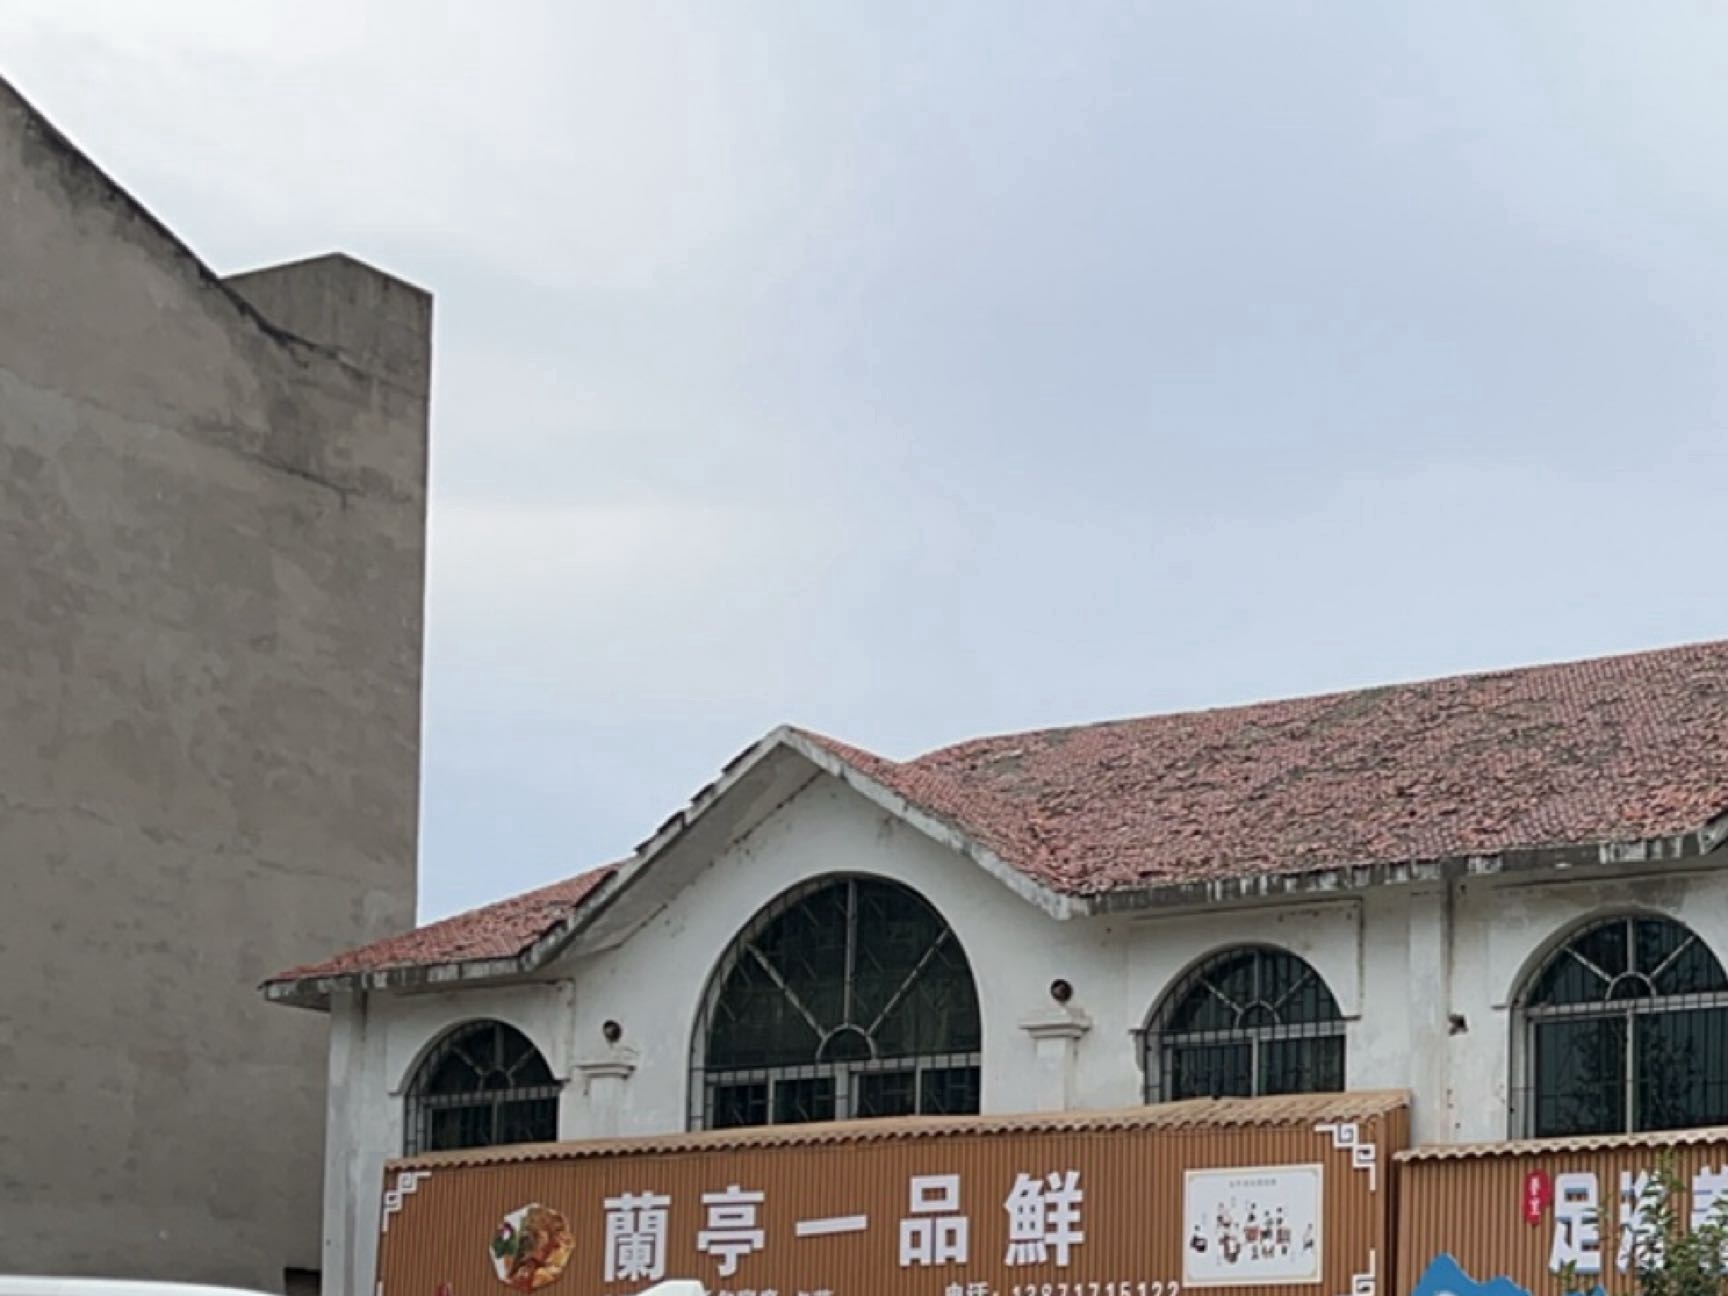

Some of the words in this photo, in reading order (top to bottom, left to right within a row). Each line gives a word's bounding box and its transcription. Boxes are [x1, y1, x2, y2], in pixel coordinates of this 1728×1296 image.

[604, 1170, 1085, 1281] 蘭亭一品鮮
